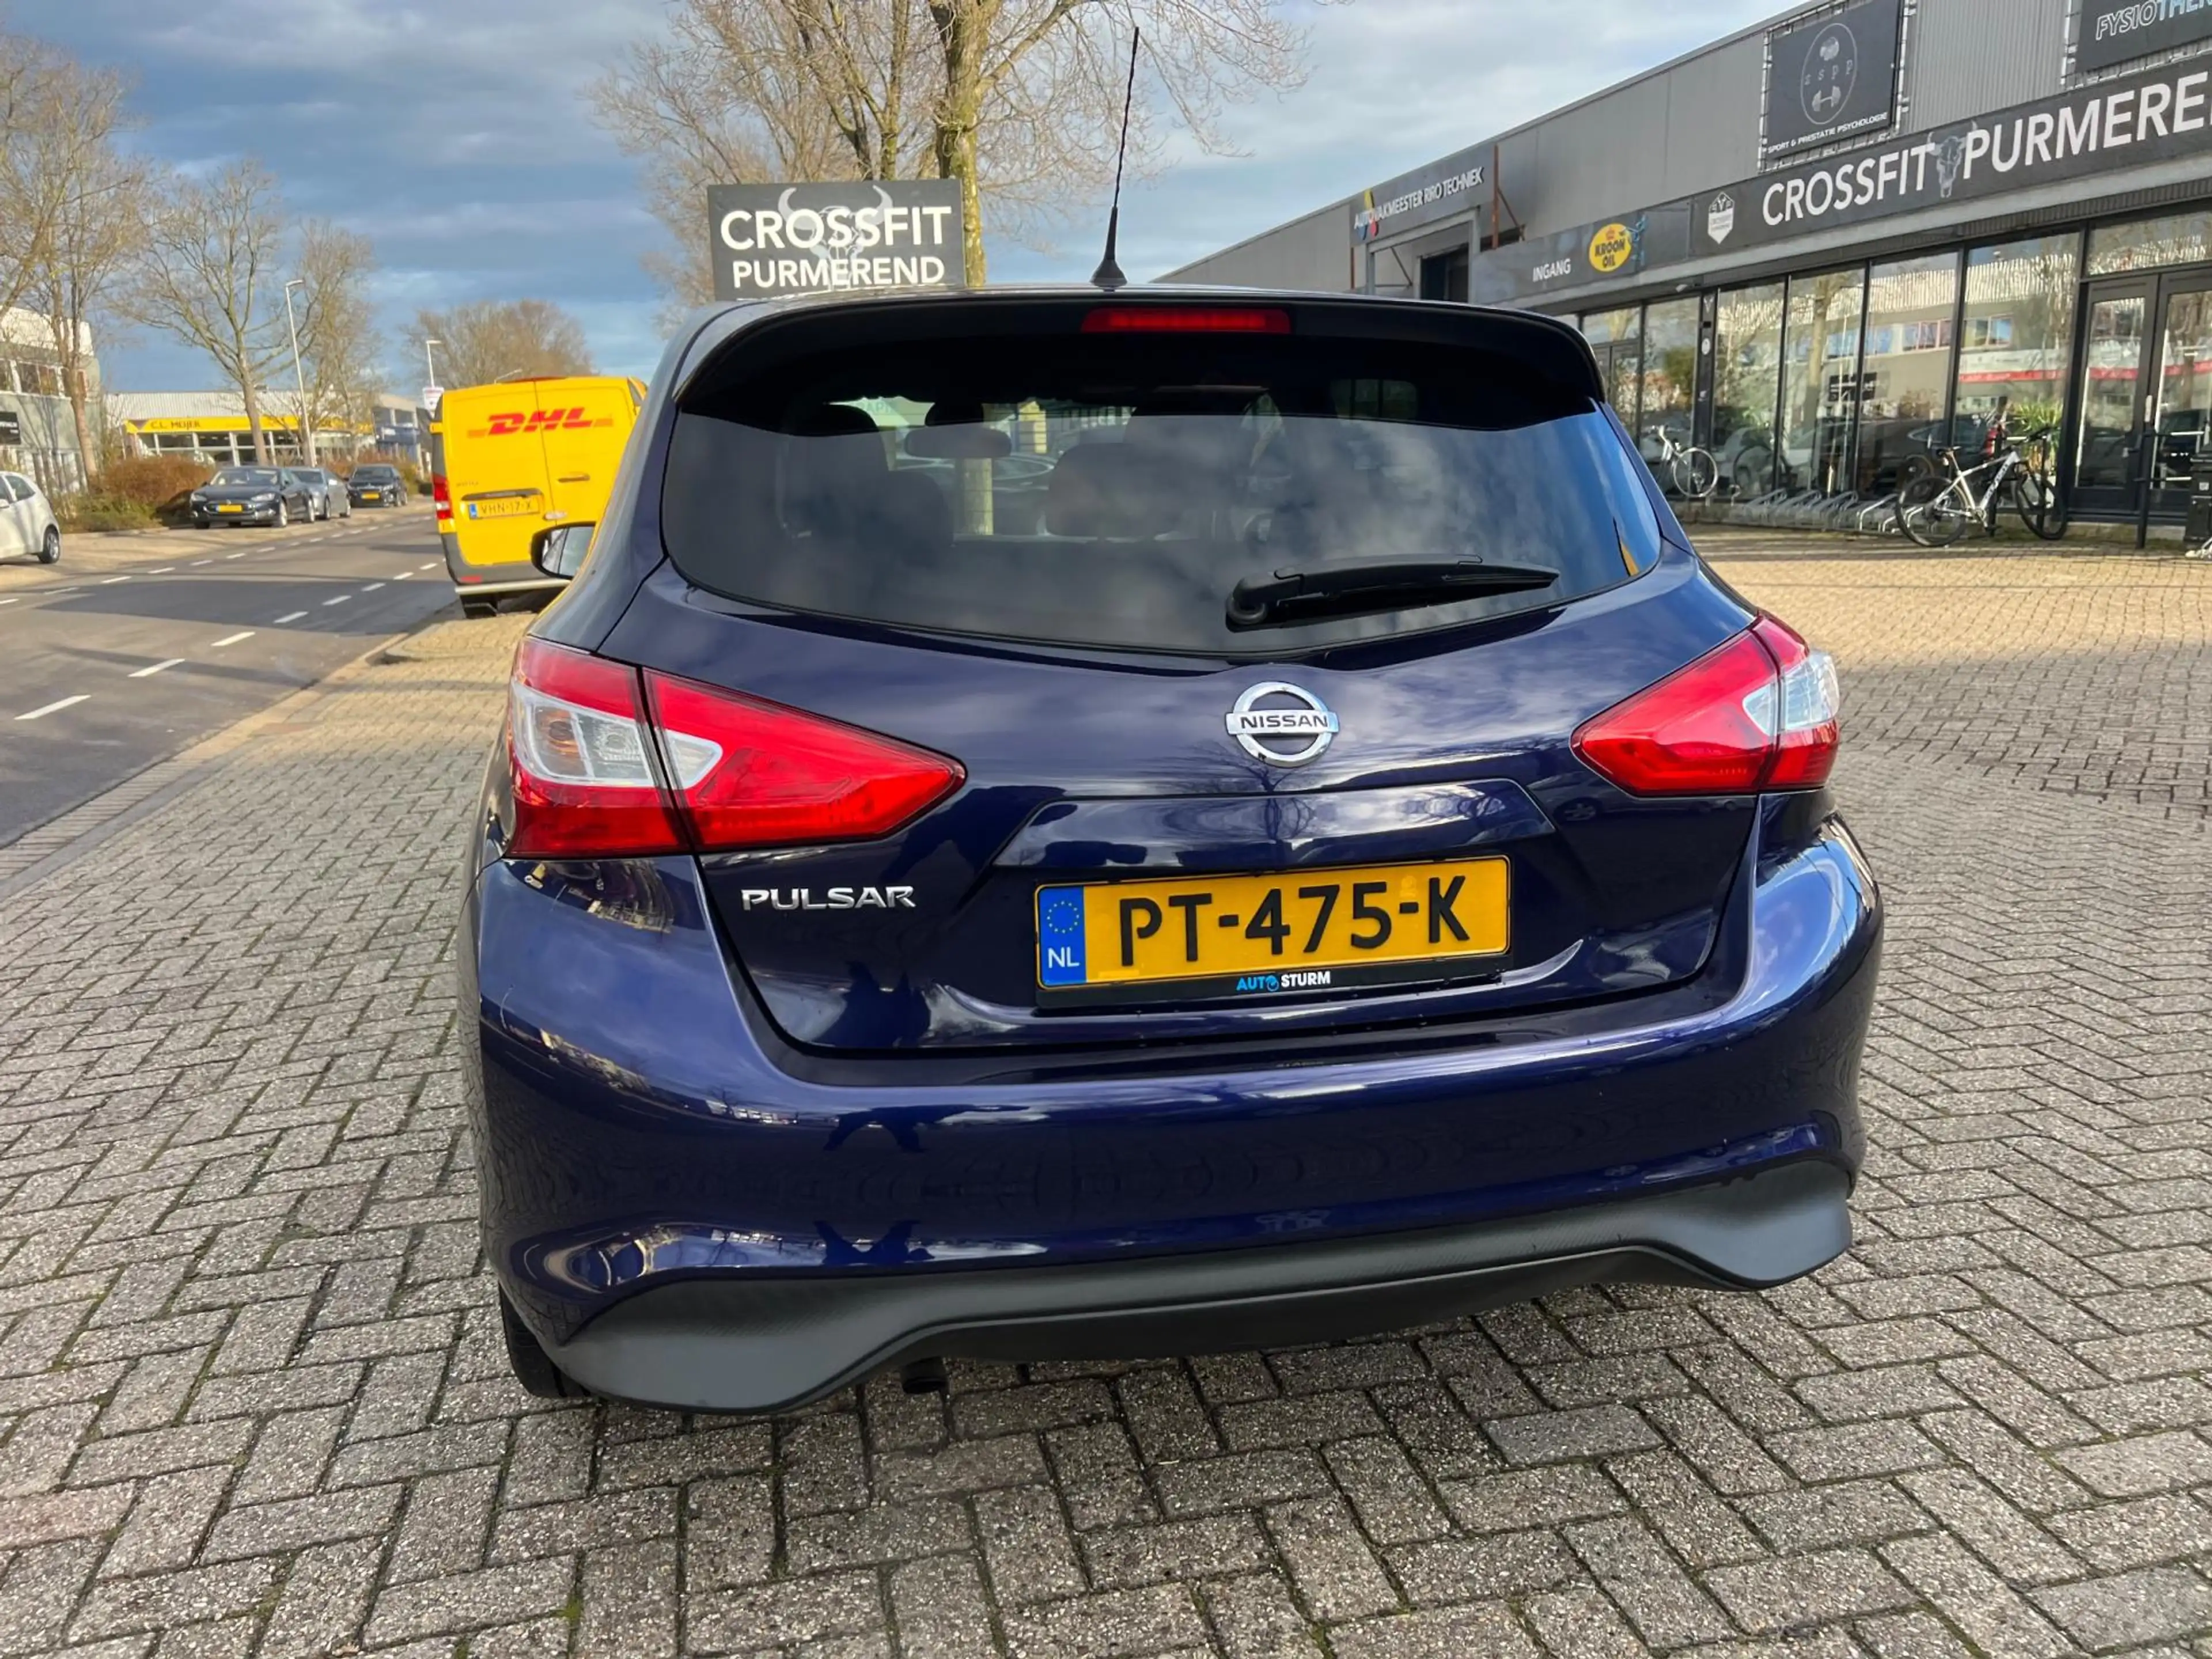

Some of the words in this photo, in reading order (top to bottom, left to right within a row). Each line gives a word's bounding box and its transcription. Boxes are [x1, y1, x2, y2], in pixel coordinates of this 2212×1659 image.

[2096, 0, 2212, 40] FYSIOTH
[1762, 143, 1935, 225] CROSSFIT
[1963, 71, 2212, 179] PURMERE
[1768, 141, 1790, 154] SPORT
[1798, 127, 1835, 145] PRESTATIE
[1837, 112, 1888, 132] PSYCHOLOGIE
[1442, 166, 1483, 198] TECHNIEK
[720, 206, 952, 250] CROSSFIT
[1594, 238, 1625, 257] KROON
[1602, 254, 1616, 268] OIL
[732, 256, 945, 288] PURMEREND
[1532, 258, 1571, 282] INGANG
[487, 407, 593, 435] DHL
[1240, 714, 1328, 729] NISSAN
[741, 885, 916, 911] PULSAR
[1047, 946, 1080, 968] NL
[1119, 875, 1470, 967] PT-475-K
[1281, 971, 1331, 988] STURM
